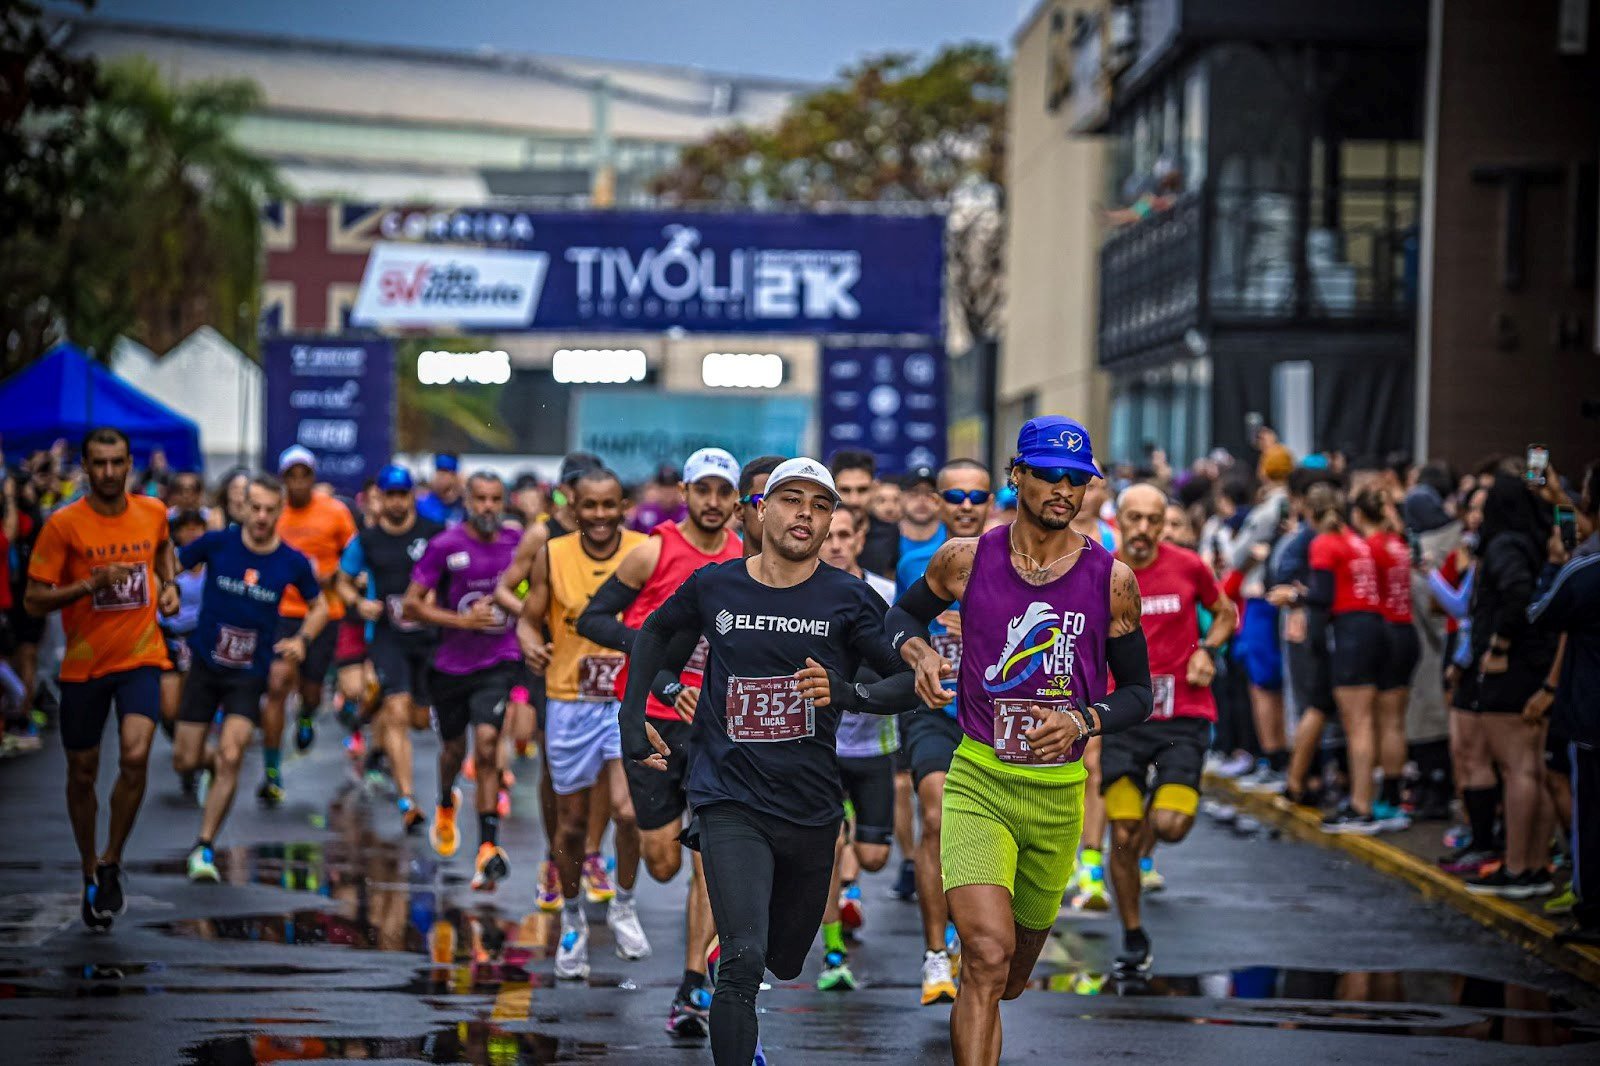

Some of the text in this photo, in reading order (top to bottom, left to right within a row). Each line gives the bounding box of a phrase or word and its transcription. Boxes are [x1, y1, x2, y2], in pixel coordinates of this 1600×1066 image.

[754, 264, 861, 319] 21K
[735, 615, 830, 637] ELETROMEI
[1062, 611, 1086, 636] FO
[1054, 633, 1076, 655] RE
[1043, 653, 1074, 676] VER
[740, 691, 802, 716] 1352
[760, 716, 786, 727] LUCAS
